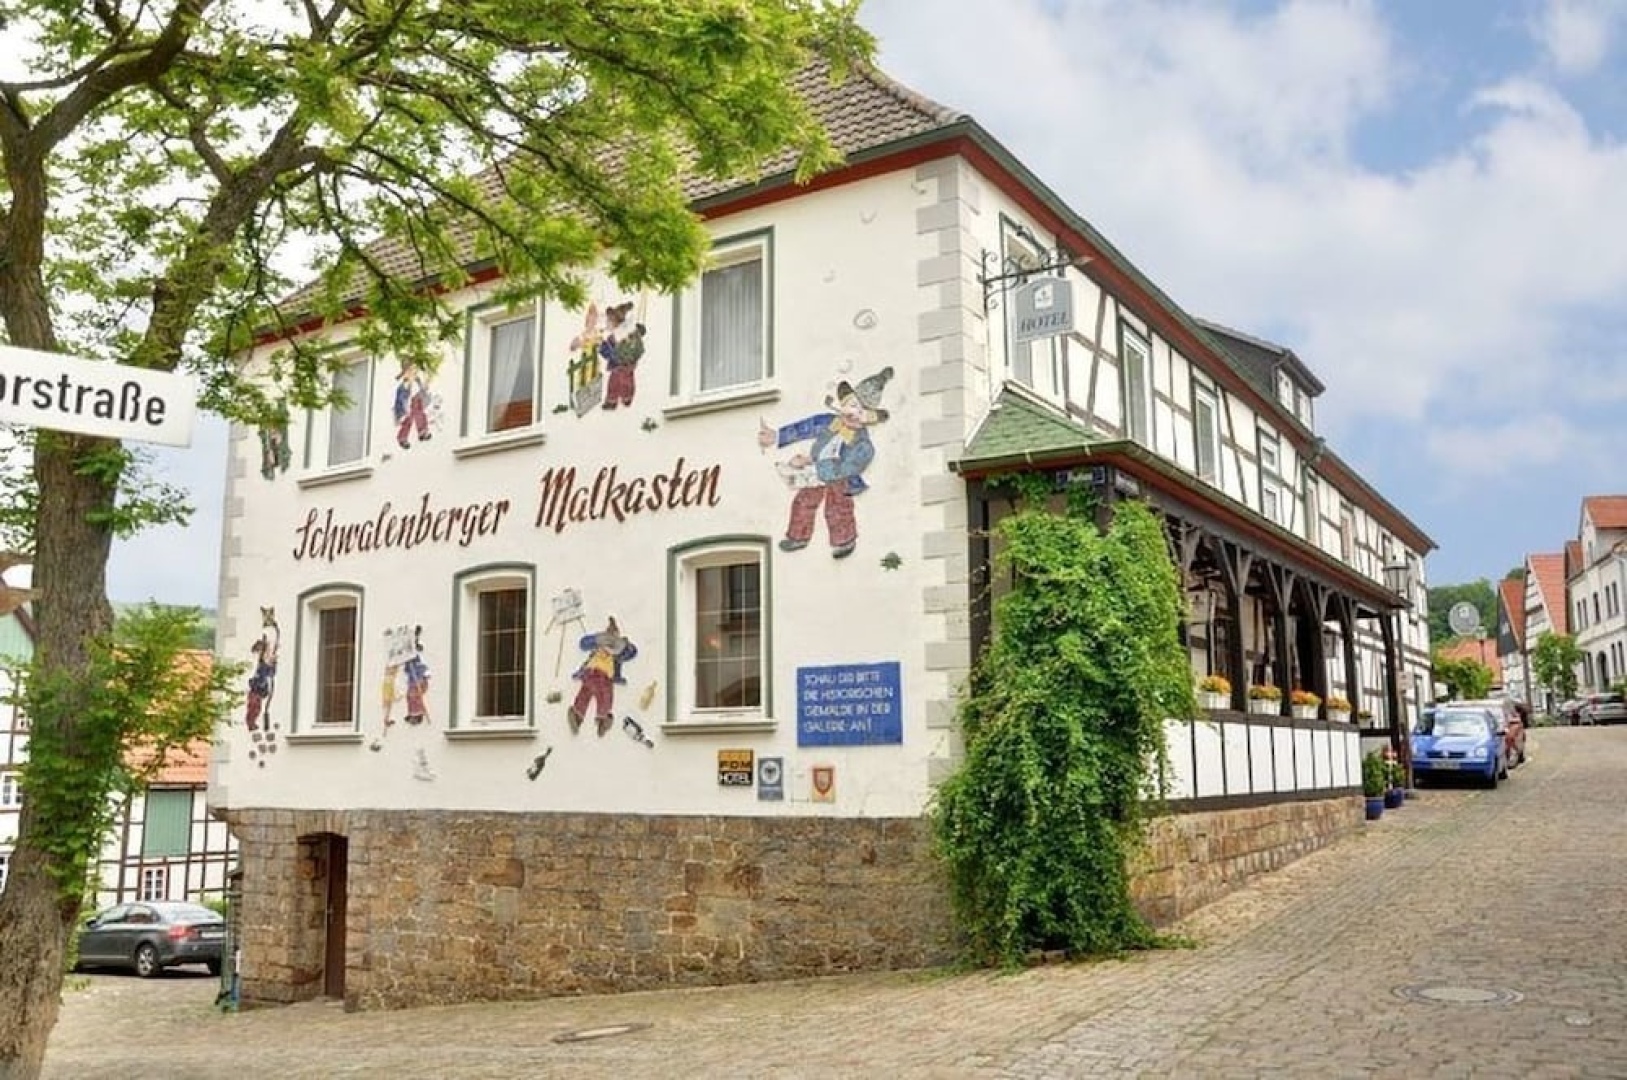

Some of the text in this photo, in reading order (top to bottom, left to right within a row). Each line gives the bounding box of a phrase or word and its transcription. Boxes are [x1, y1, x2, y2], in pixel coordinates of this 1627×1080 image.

[293, 457, 721, 563] Schwalenberger Malkasten
[719, 772, 752, 786] HOTEL
